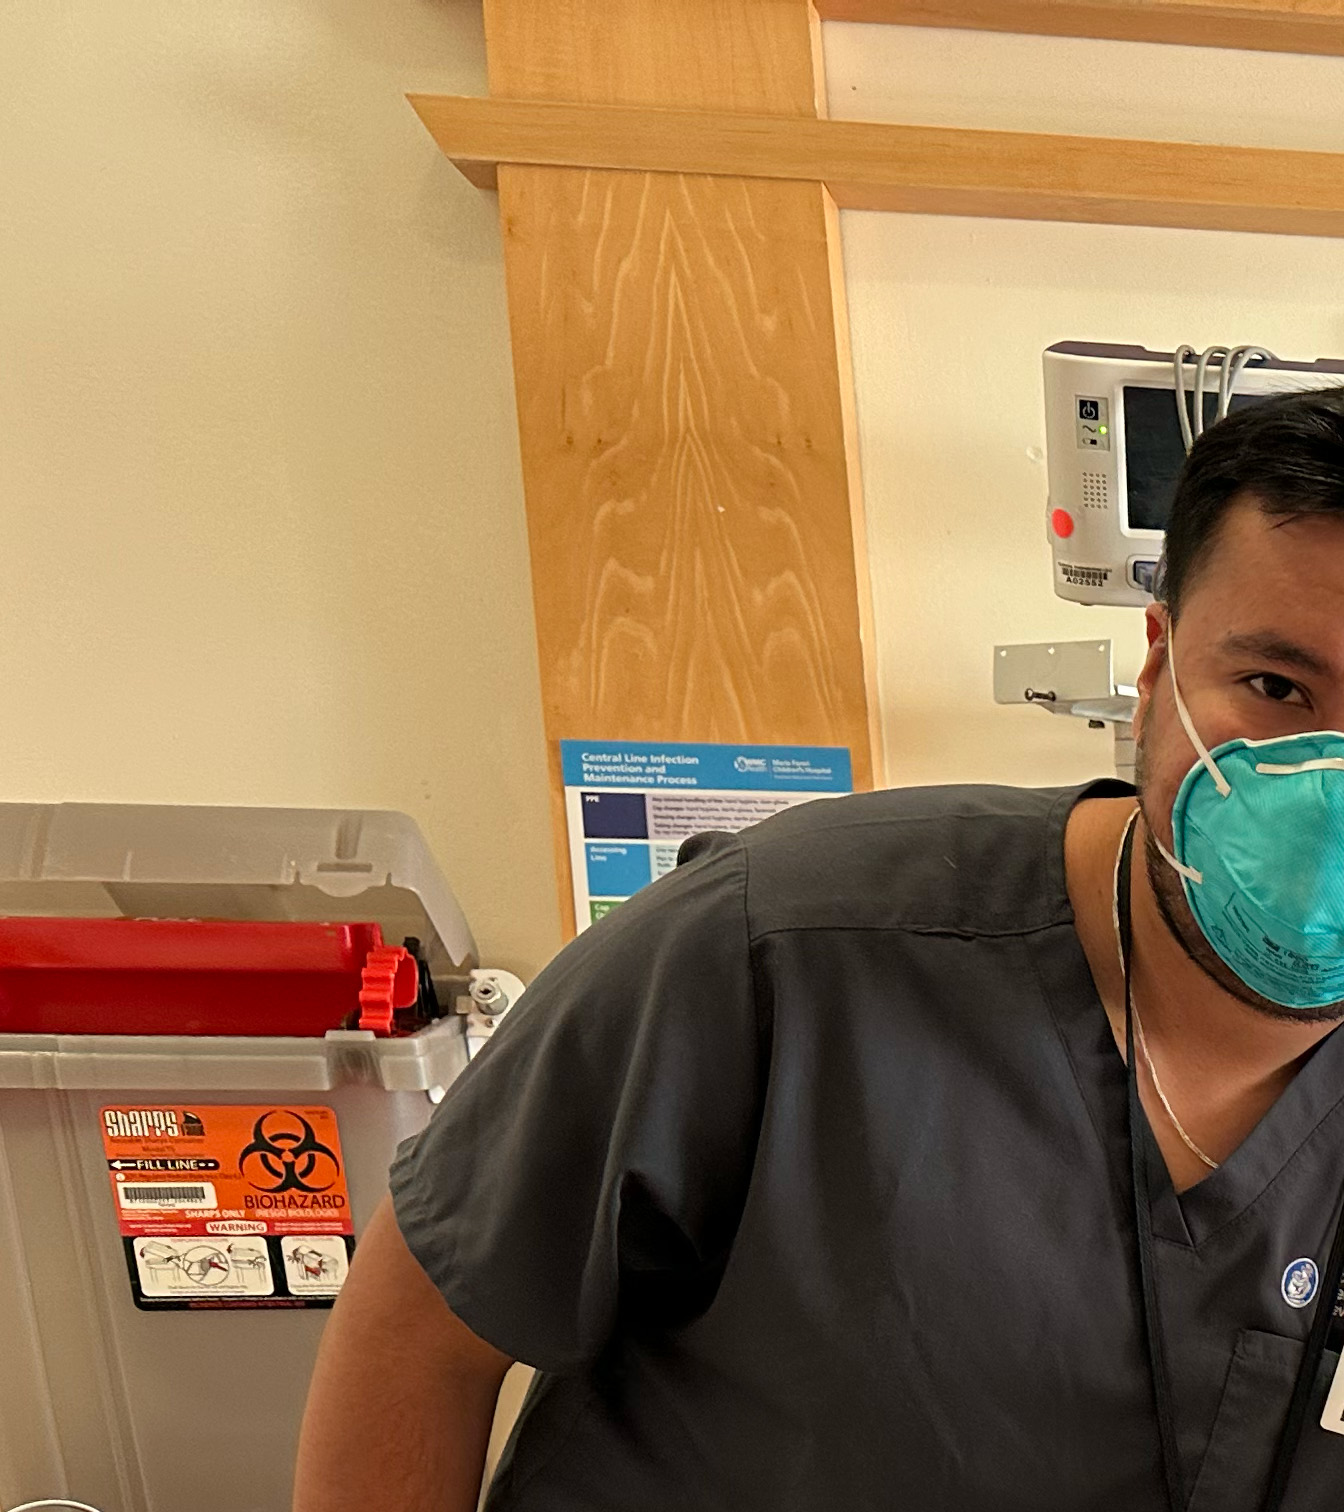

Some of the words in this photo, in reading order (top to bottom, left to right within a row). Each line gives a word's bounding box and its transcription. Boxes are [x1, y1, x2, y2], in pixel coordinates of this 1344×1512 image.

[581, 752, 622, 763] Central
[624, 753, 648, 763] Line
[650, 754, 699, 765] Infection
[582, 762, 643, 773] Prevention
[645, 764, 667, 774] and
[583, 772, 655, 784] Maintenance
[657, 774, 698, 785] Process
[136, 1159, 164, 1171] FILL
[166, 1159, 200, 1171] LINE
[244, 1194, 346, 1210] BIOHAZARD
[184, 1208, 221, 1219] SHARPS
[221, 1208, 246, 1218] ONLY
[209, 1222, 265, 1232] WARNING
